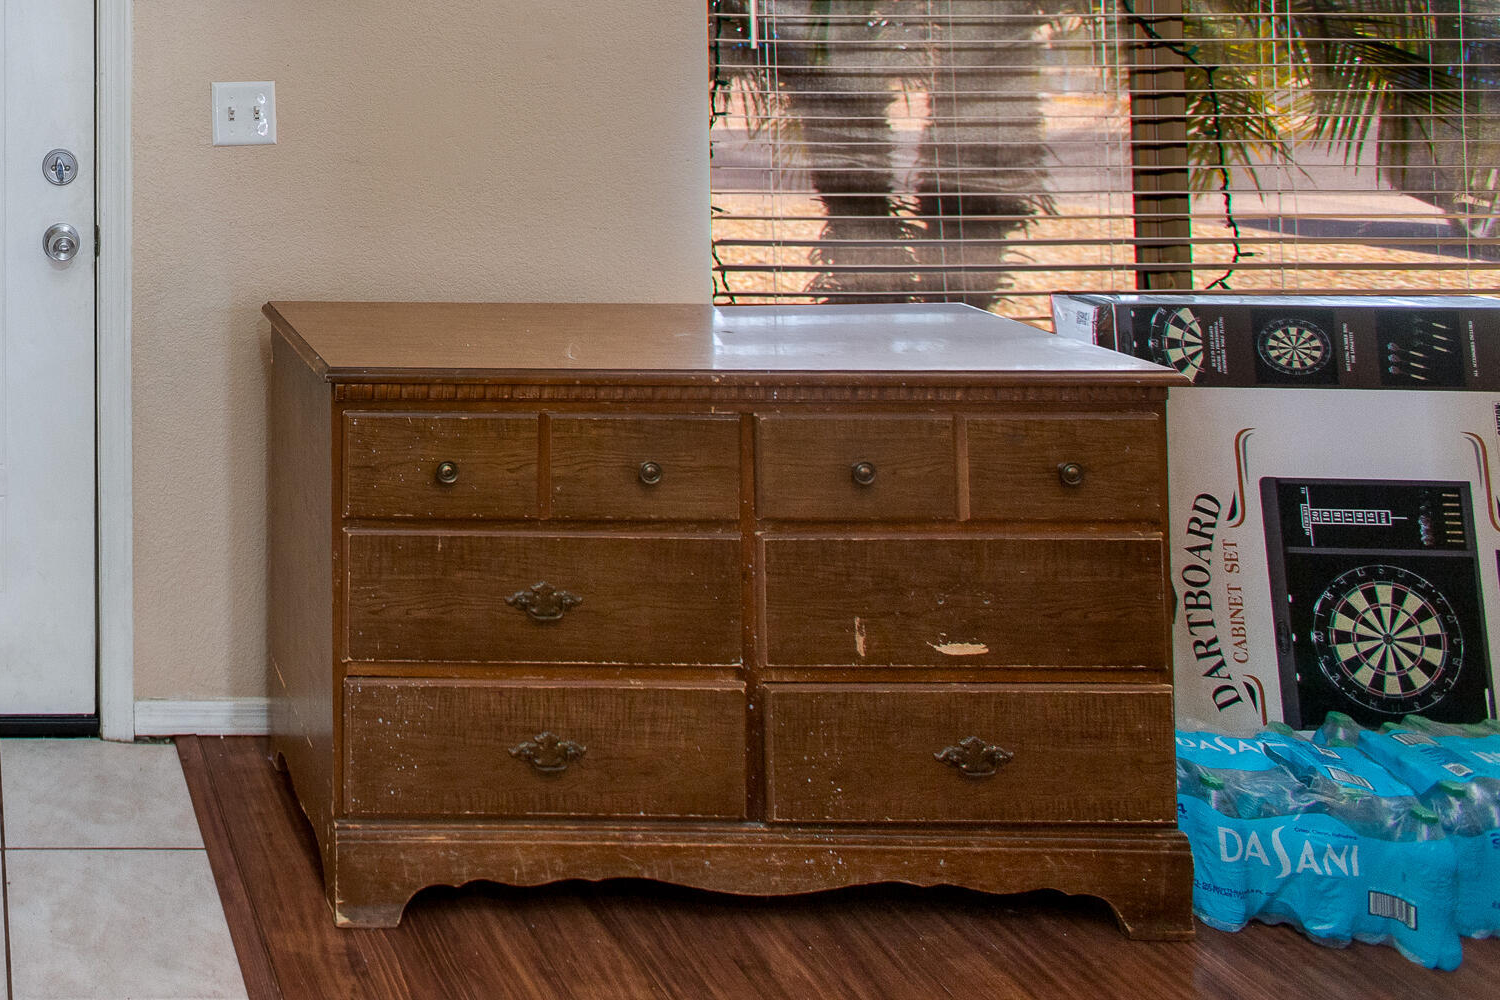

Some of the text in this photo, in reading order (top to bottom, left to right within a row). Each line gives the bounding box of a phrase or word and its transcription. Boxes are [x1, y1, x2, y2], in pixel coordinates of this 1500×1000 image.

[1311, 511, 1320, 522] 20
[1322, 511, 1331, 522] 19
[1333, 511, 1342, 522] 18
[1345, 512, 1353, 523] 17
[1367, 512, 1376, 523] 15
[1180, 491, 1245, 713] DARTBOARD
[1222, 538, 1251, 665] CABINET SET
[1217, 825, 1360, 879] DASANI
